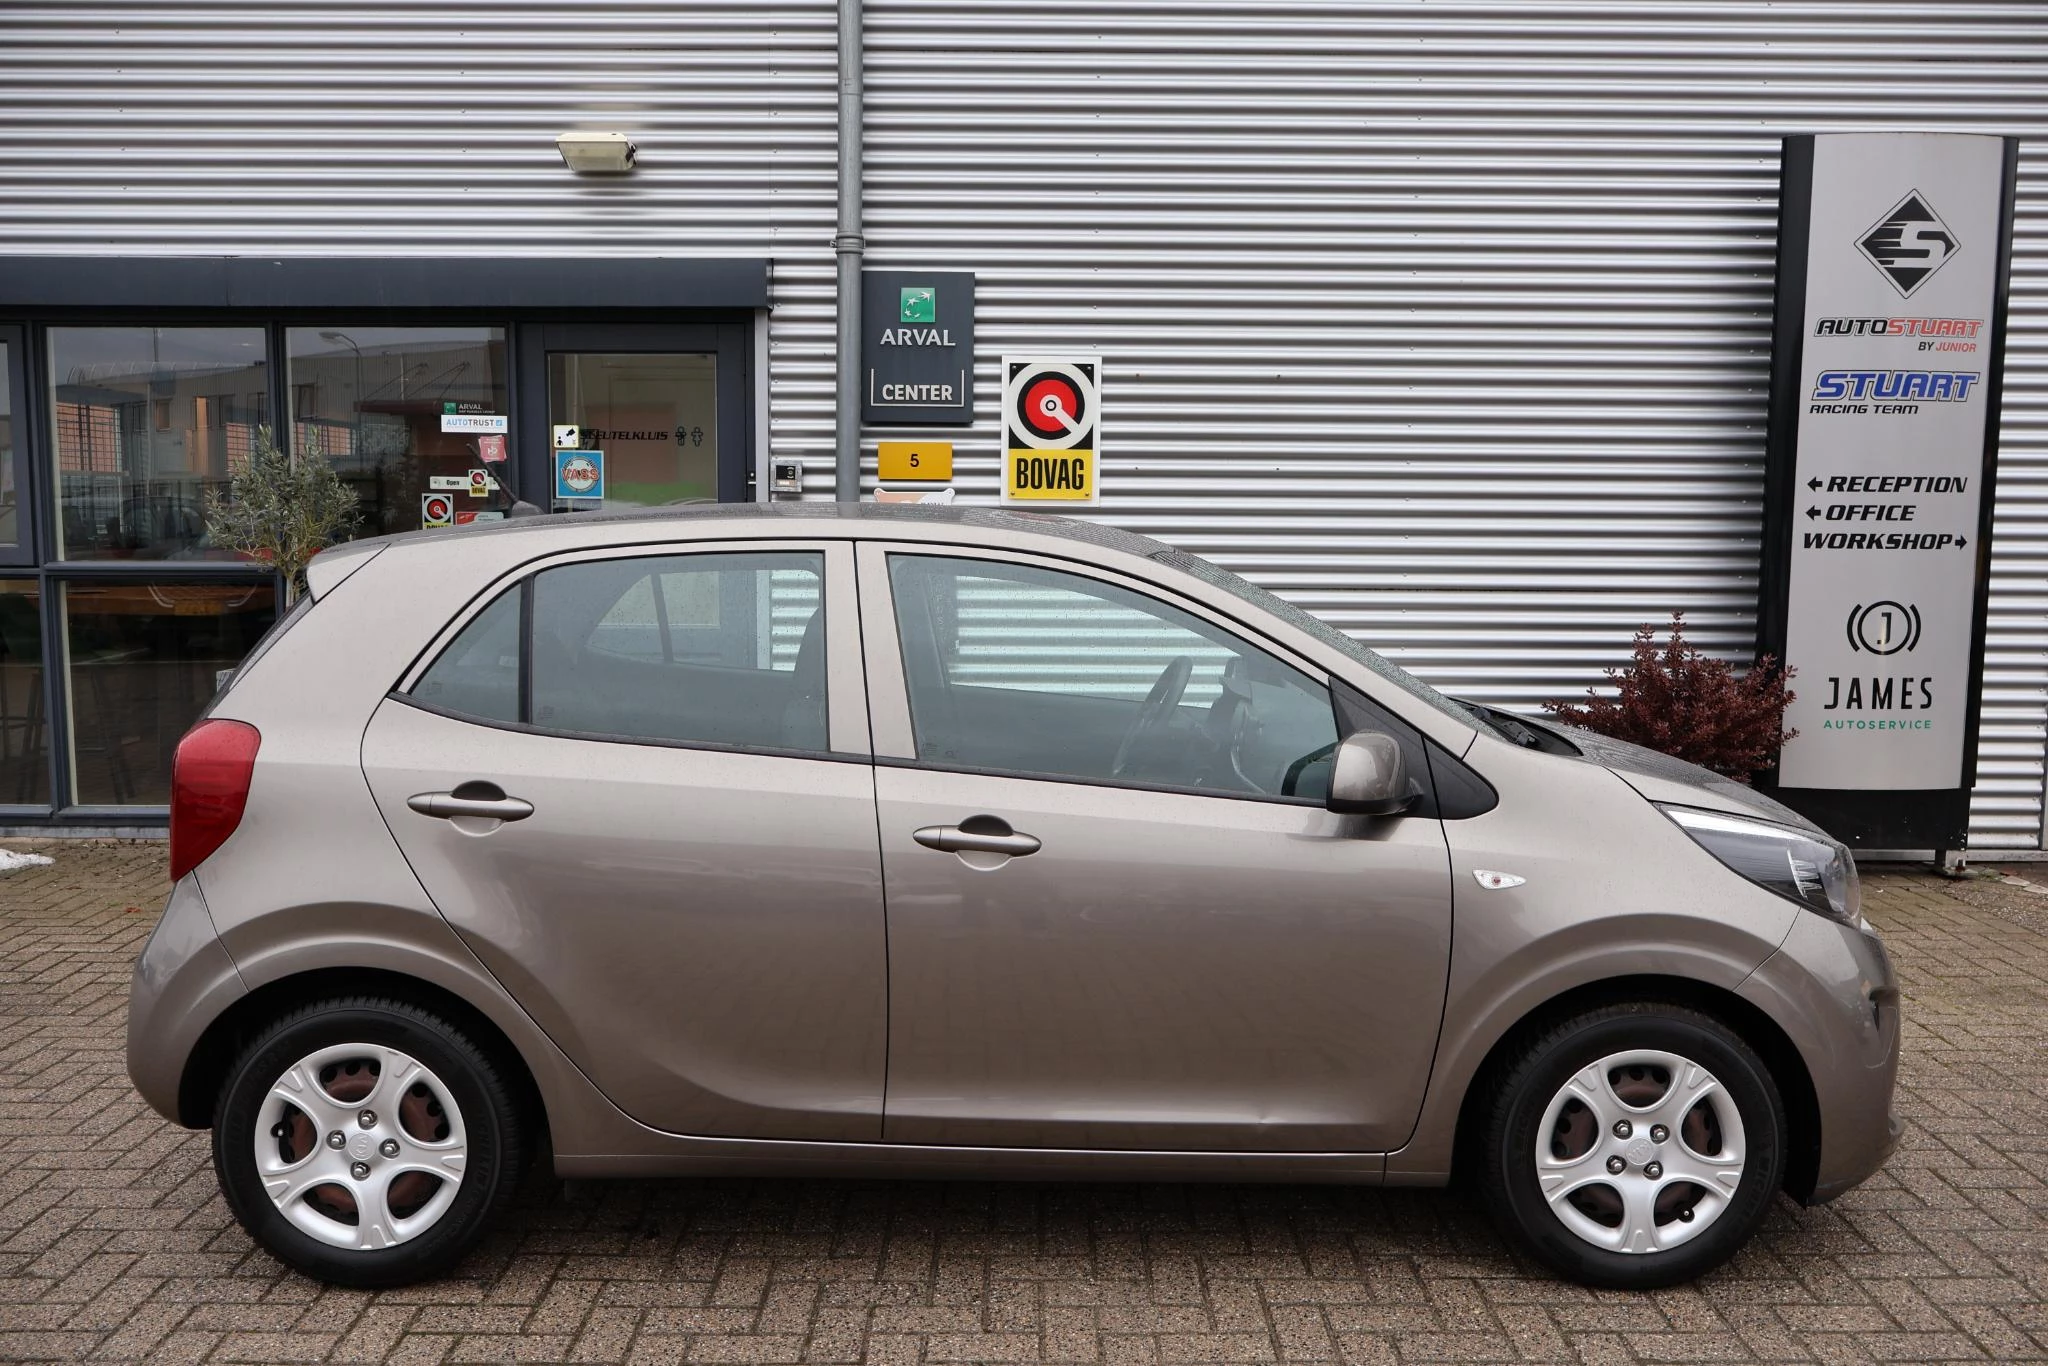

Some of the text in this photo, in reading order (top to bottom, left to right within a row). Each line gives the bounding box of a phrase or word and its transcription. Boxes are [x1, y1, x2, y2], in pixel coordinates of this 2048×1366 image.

[1814, 316, 1984, 338] AUTOSTUART
[880, 328, 956, 346] ARVAL
[1918, 341, 1977, 353] BY JUNIOR
[881, 383, 954, 402] CENTER
[1811, 369, 1981, 402] STUART
[1809, 404, 1919, 415] RACING TEAM
[446, 418, 495, 427] AUTOTRUST
[909, 453, 920, 468] 5
[446, 479, 460, 487] Open
[1016, 458, 1085, 490] BOVAG
[1826, 475, 1968, 494] RECEPTION
[1825, 503, 1917, 521] OFFICE
[1803, 532, 1953, 550] WORKSHOP
[1823, 676, 1934, 710] JAMES
[1823, 719, 1932, 730] AUTOSERVICE
